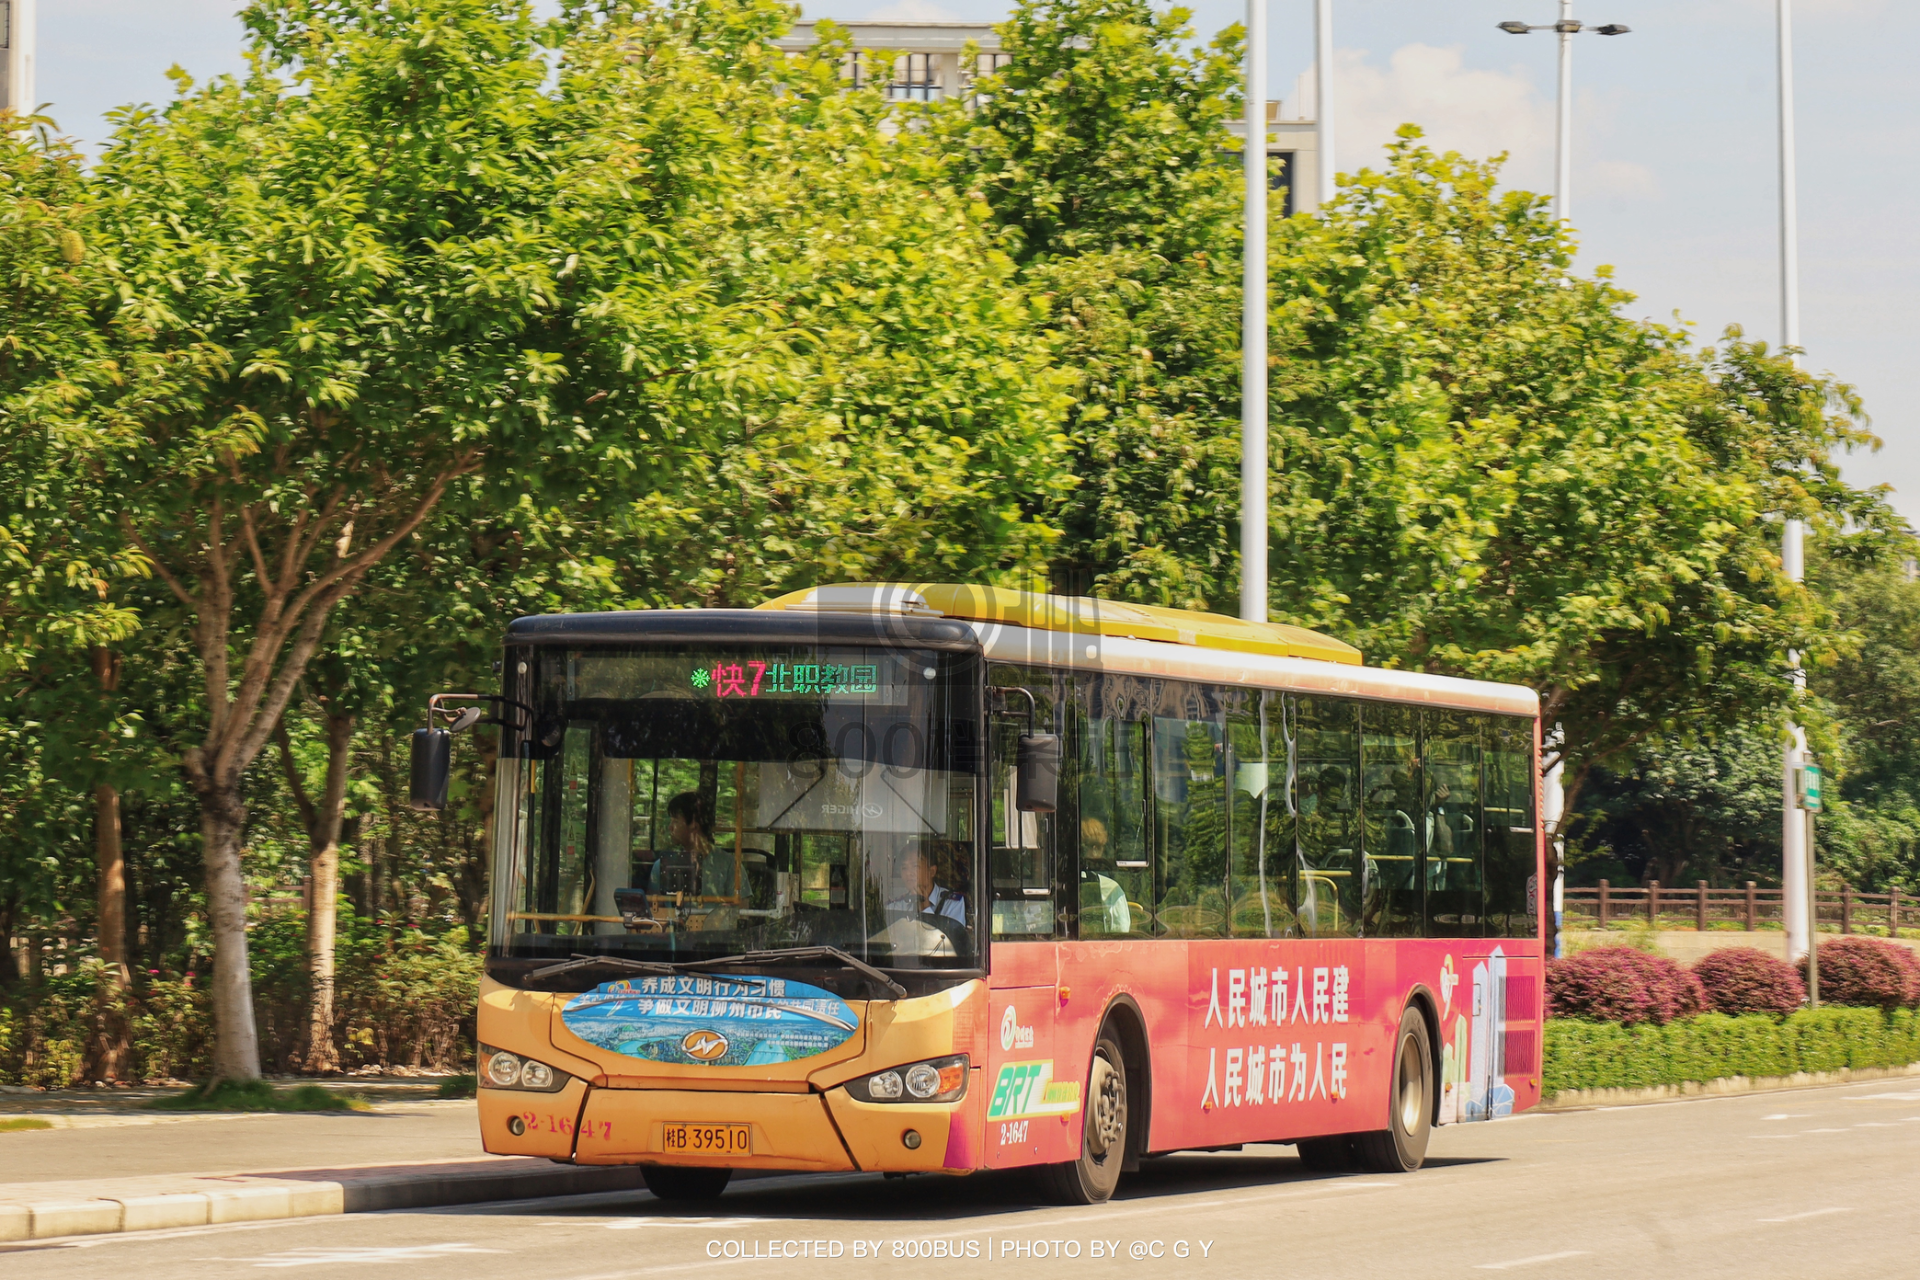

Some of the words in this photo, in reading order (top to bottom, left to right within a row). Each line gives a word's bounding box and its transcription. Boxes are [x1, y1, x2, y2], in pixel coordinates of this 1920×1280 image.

[766, 663, 877, 694] 北职教园
[641, 976, 786, 998] 养成文明行为习惯
[1204, 964, 1350, 1029] 人民城市人民建
[638, 998, 783, 1020] 争做文明柳州市民
[989, 1064, 1042, 1117] BRT
[1201, 1042, 1347, 1109] 人民城市为人民
[1000, 1120, 1029, 1145] 2-1647
